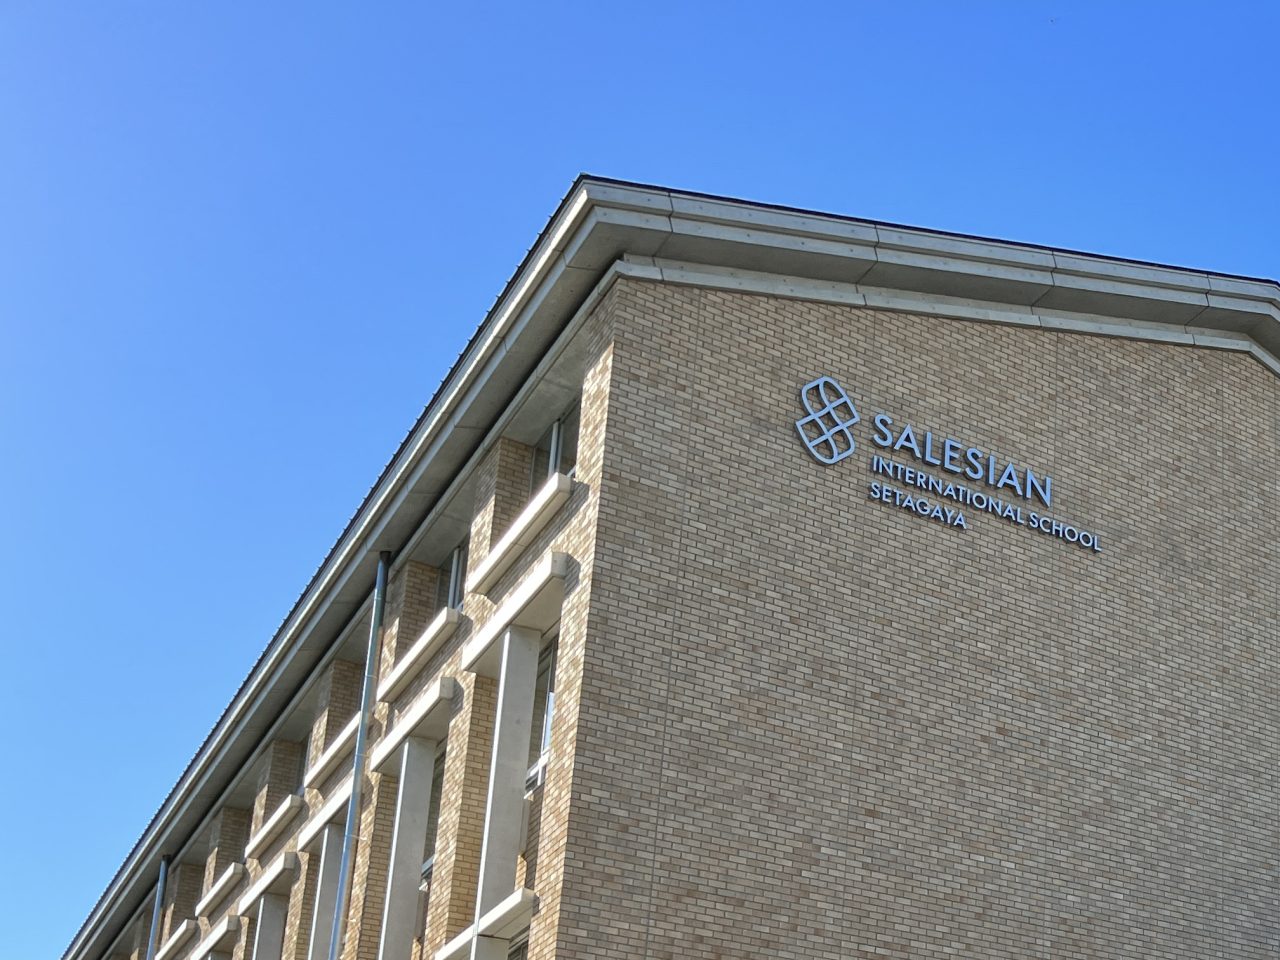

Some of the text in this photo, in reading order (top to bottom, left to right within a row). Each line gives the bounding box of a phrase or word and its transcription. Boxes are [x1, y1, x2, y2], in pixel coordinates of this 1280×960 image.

[869, 482, 968, 530] SETAGAYA
[871, 455, 1103, 553] INTERNATIONAL SCHOOL
[872, 413, 1053, 508] SALESIAN
